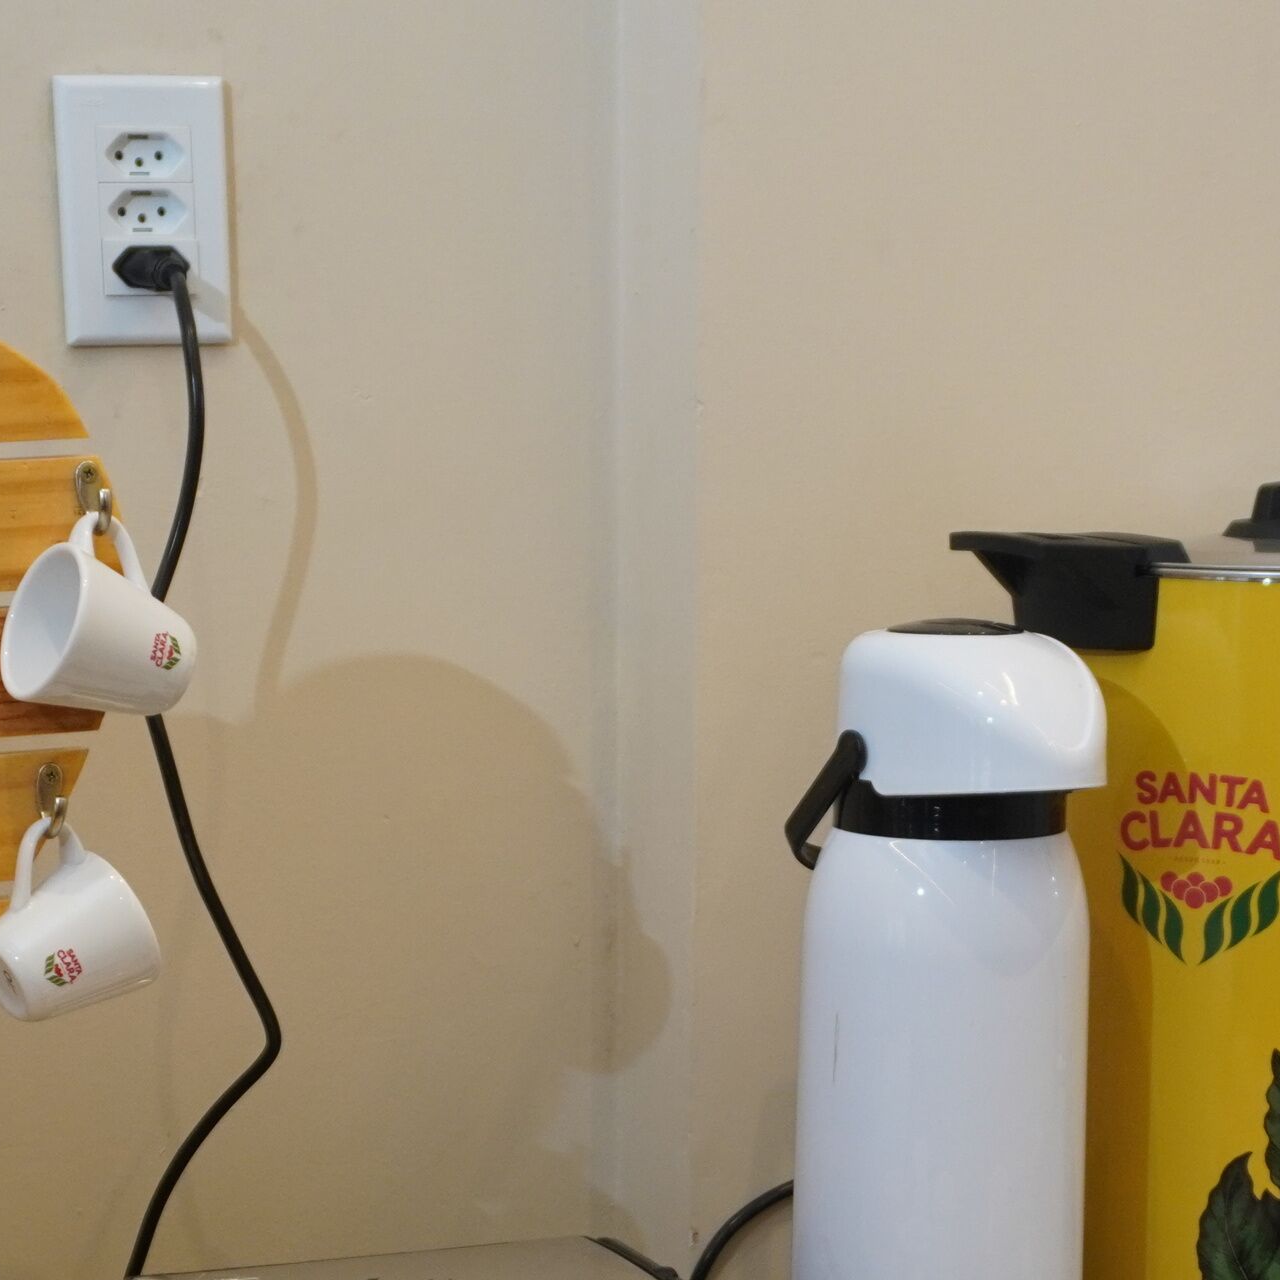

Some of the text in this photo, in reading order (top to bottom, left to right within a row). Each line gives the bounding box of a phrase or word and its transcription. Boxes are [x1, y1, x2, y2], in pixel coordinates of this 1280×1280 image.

[1135, 770, 1269, 814] SANTA
[57, 949, 76, 984] CLARA
[66, 948, 82, 976] SANTA
